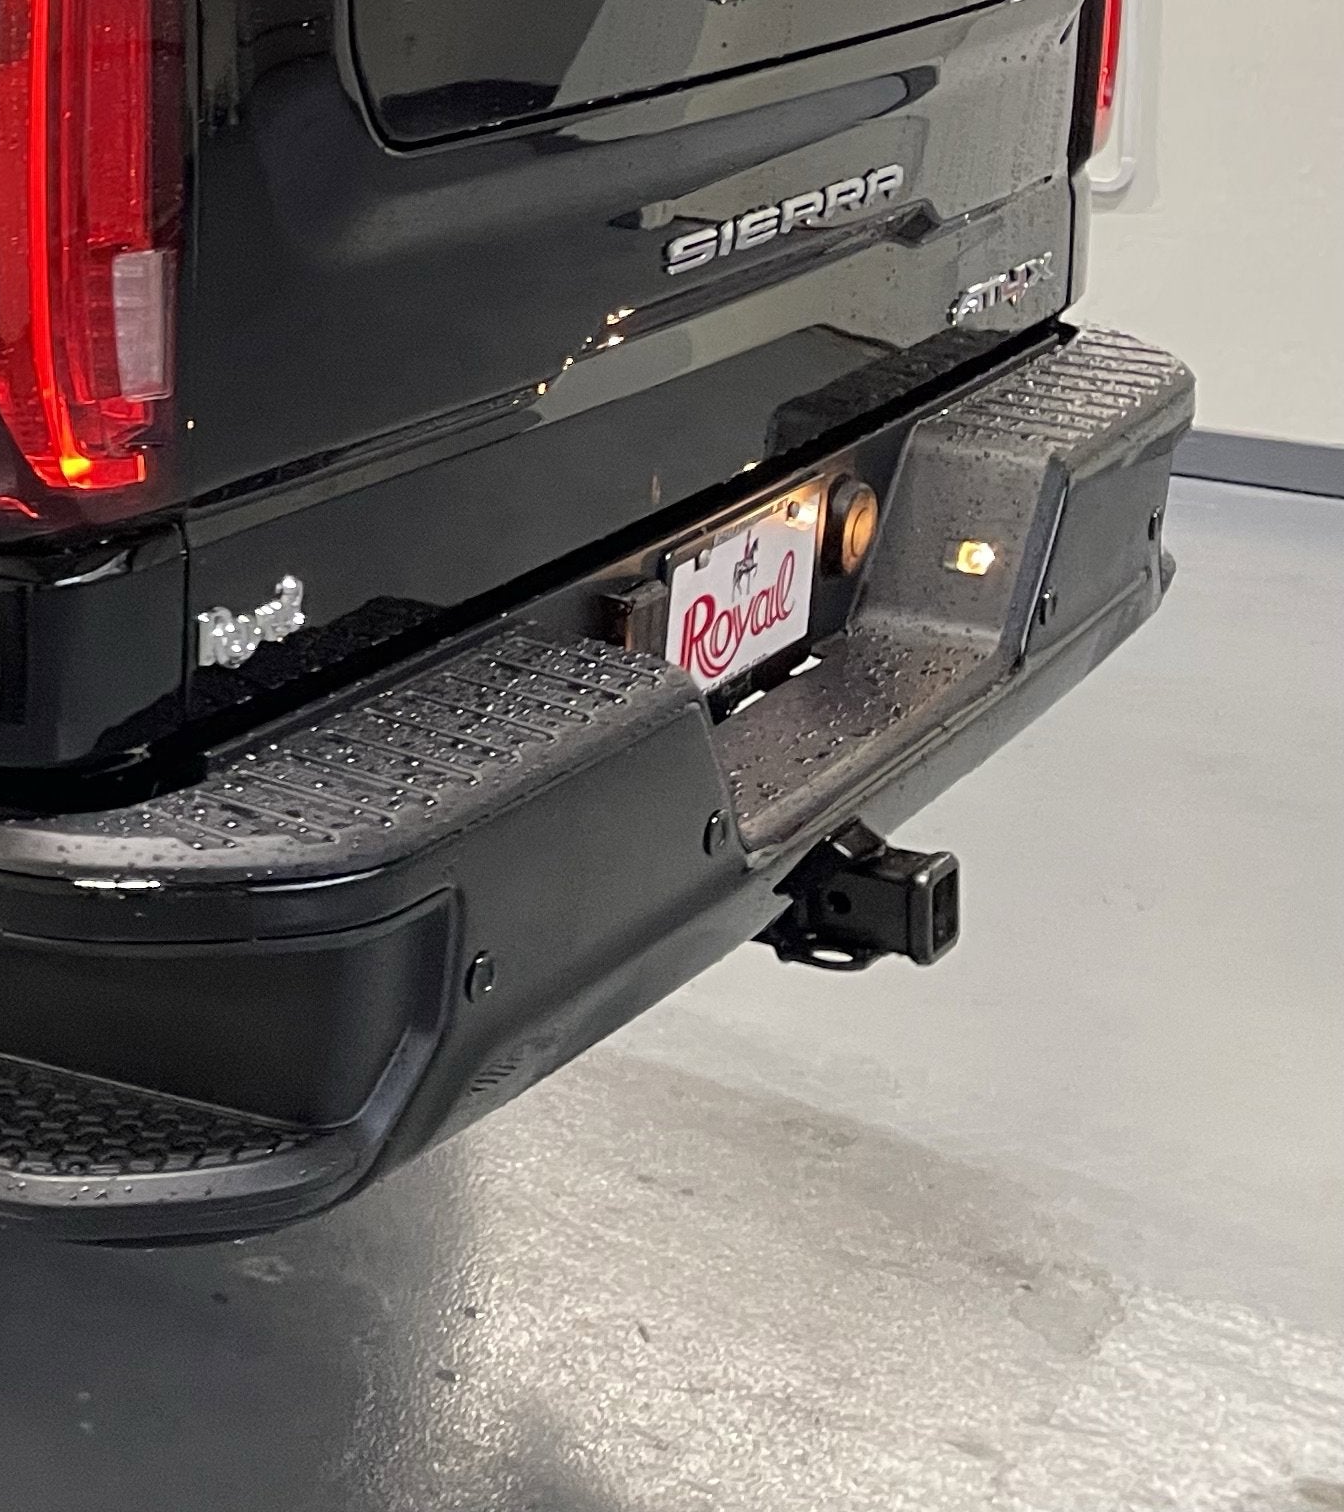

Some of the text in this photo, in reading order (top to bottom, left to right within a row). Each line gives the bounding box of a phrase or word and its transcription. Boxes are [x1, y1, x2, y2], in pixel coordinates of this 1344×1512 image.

[665, 163, 905, 276] SIERRA
[947, 250, 1053, 326] AT4X
[679, 549, 795, 679] Royal
